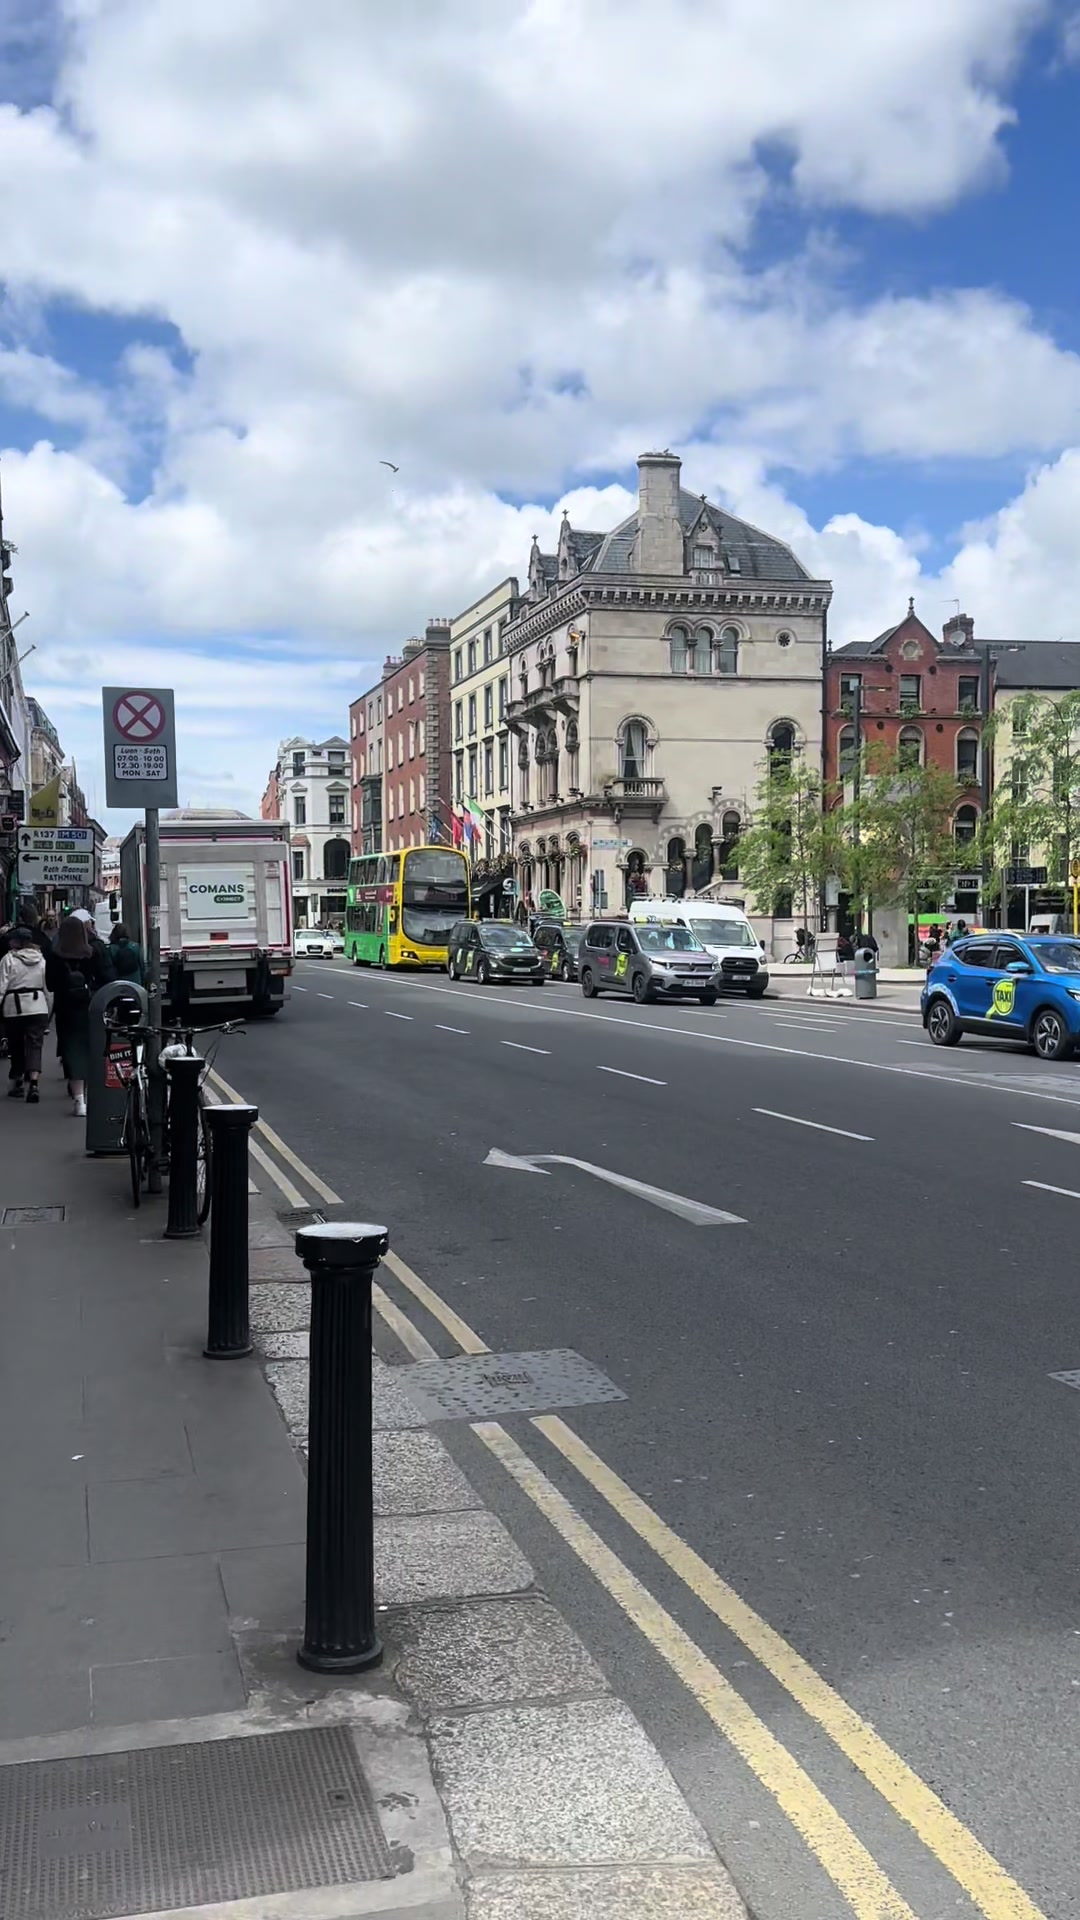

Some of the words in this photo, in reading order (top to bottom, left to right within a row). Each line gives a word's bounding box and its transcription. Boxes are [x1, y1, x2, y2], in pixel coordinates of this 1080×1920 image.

[189, 884, 245, 894] COMANS
[996, 990, 1012, 1002] TAXI
[109, 1051, 124, 1061] BIN
